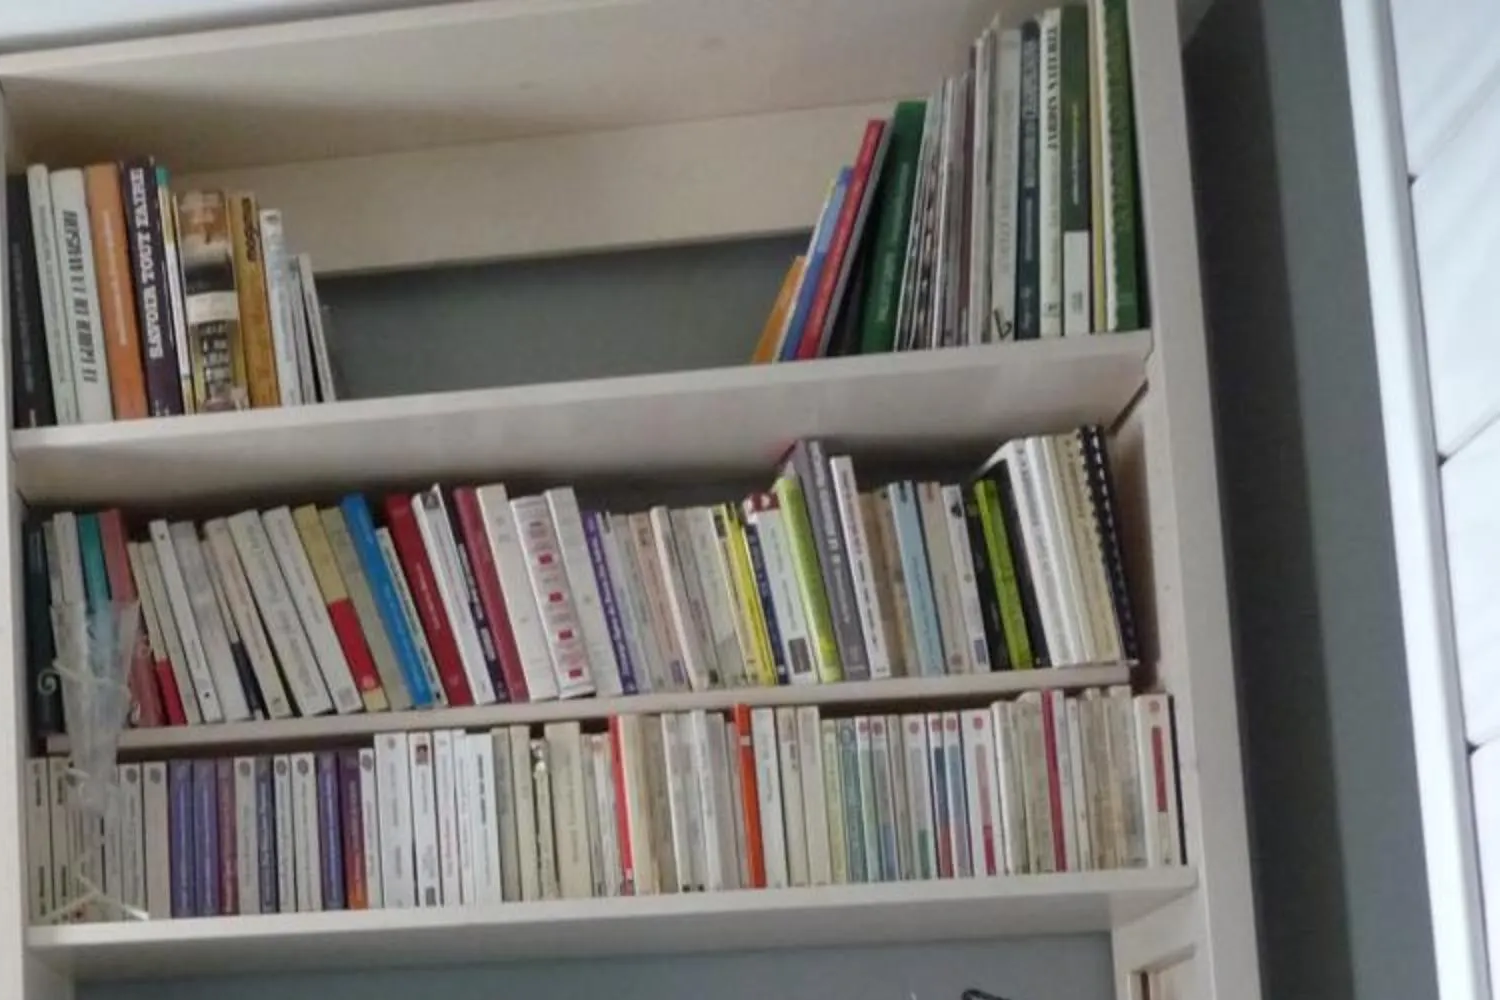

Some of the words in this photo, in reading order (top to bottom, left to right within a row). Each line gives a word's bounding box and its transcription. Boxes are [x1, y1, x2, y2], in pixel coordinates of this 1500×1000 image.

[129, 167, 149, 228] FAIRE
[137, 231, 156, 283] TOUT
[142, 284, 164, 360] SAVOIR
